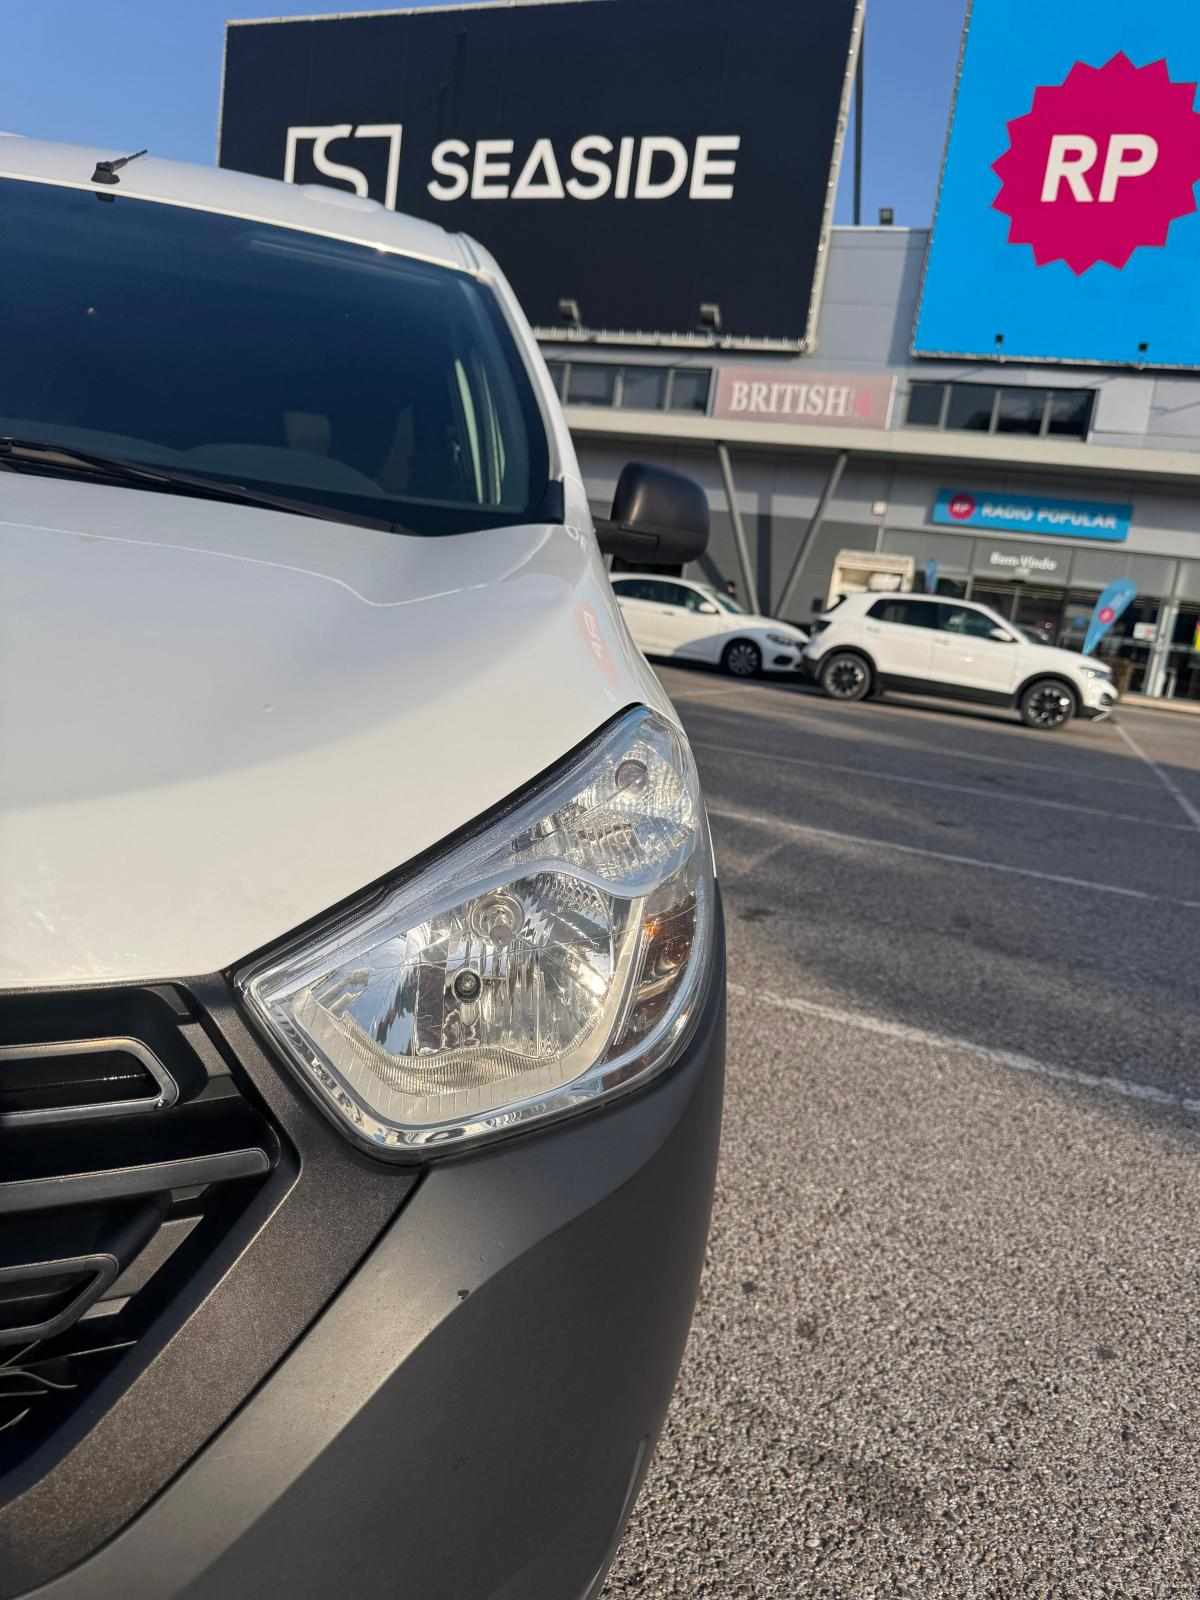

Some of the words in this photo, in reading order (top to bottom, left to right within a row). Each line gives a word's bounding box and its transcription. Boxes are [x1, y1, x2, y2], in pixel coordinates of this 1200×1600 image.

[428, 135, 740, 201] SEASIDE
[1040, 133, 1159, 203] RP
[728, 381, 850, 416] BRITISH
[1036, 511, 1117, 529] POPULAR
